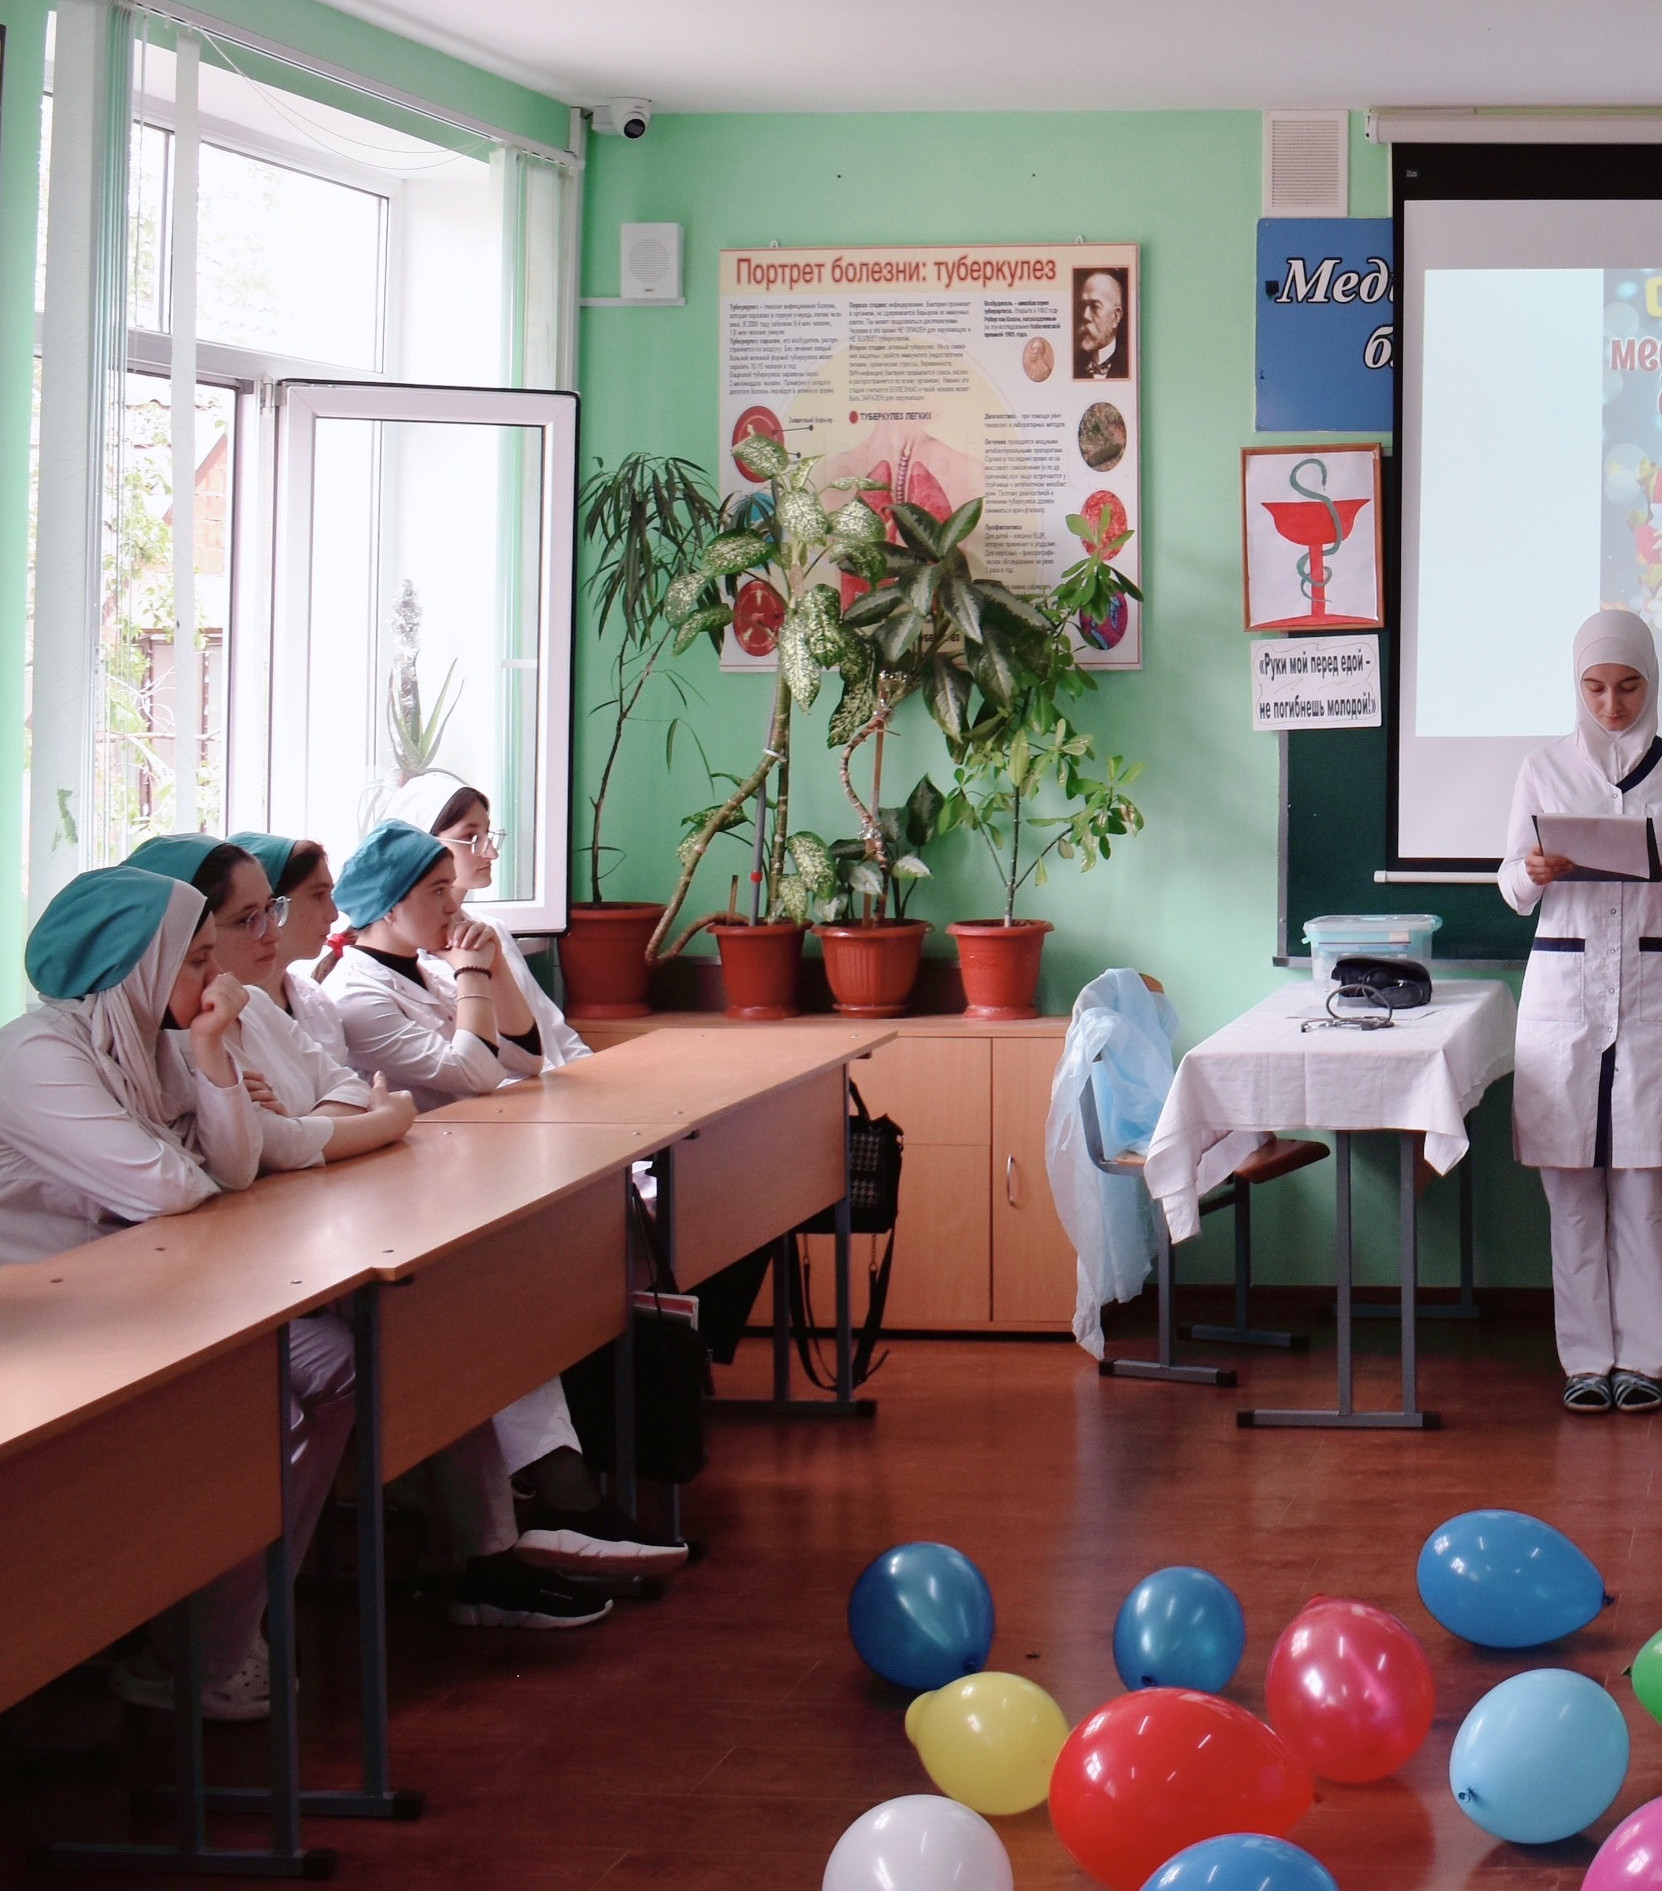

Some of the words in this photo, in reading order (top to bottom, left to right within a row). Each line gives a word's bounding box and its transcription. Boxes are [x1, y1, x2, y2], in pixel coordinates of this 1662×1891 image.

[737, 258, 825, 290] Портрет
[831, 256, 926, 283] болезни:
[934, 255, 1056, 288] туберкулез
[1364, 324, 1393, 369] б
[1260, 652, 1287, 681] «Руки
[1290, 651, 1308, 674] мой
[1311, 655, 1339, 679] перед
[1341, 649, 1363, 676] едой
[1260, 702, 1271, 719] не
[1273, 695, 1325, 718] погибнешь
[1327, 691, 1377, 720] молодой!»
